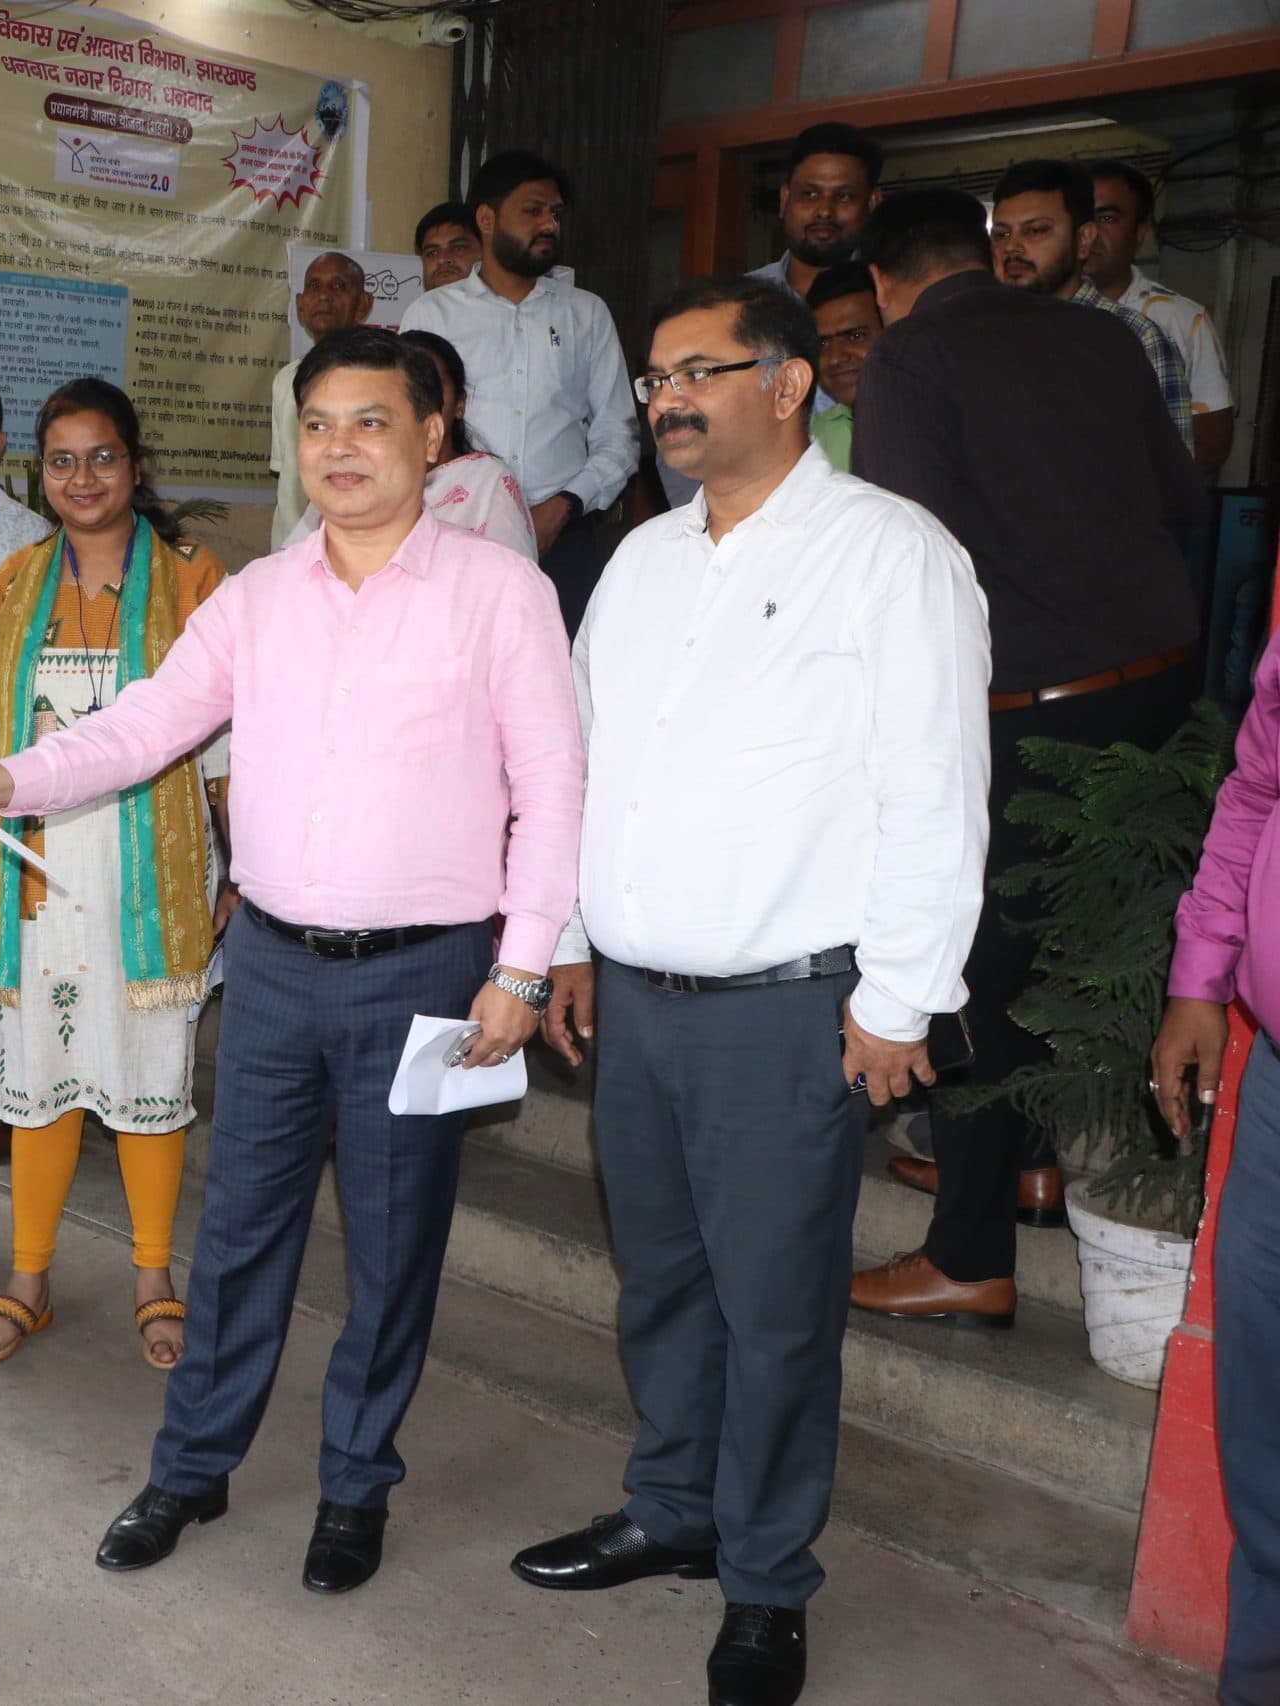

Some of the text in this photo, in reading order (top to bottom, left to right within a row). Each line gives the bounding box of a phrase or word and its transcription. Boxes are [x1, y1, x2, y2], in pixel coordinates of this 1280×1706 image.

[57, 25, 86, 52] एवं
[81, 35, 134, 63] आवास
[138, 38, 190, 78] विभाग,
[195, 59, 257, 92] झारखण्ड
[1, 55, 60, 82] धनबाद
[63, 66, 104, 92] नगर
[164, 86, 215, 114] धनबाद
[49, 101, 89, 121] प्रधानमंत्री
[91, 109, 117, 126] आवास
[150, 173, 170, 193] 2.0
